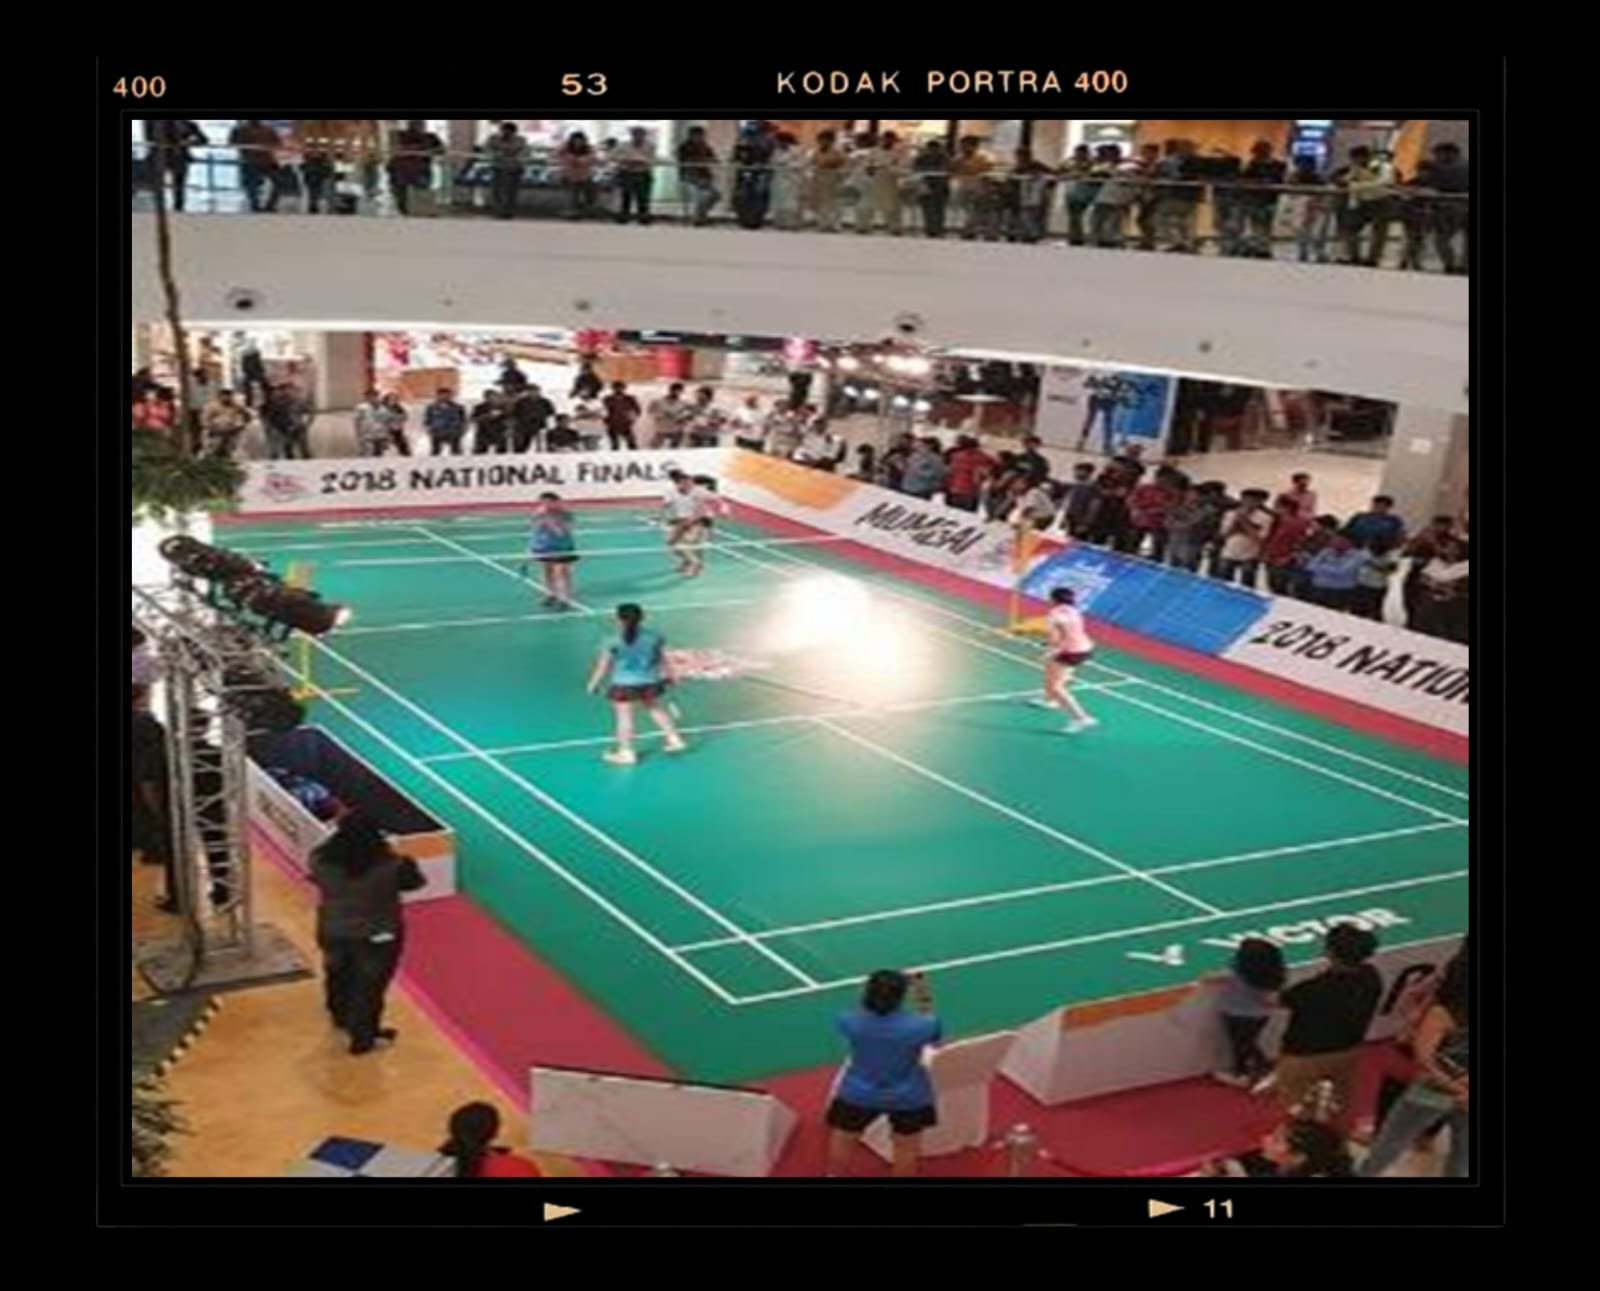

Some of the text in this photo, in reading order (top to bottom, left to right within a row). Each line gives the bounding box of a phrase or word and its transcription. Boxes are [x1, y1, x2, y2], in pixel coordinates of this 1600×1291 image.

[320, 468, 397, 494] 2018
[409, 462, 564, 492] NATIONAL
[854, 501, 985, 556] MUMBAI
[1250, 620, 1352, 660] 2018
